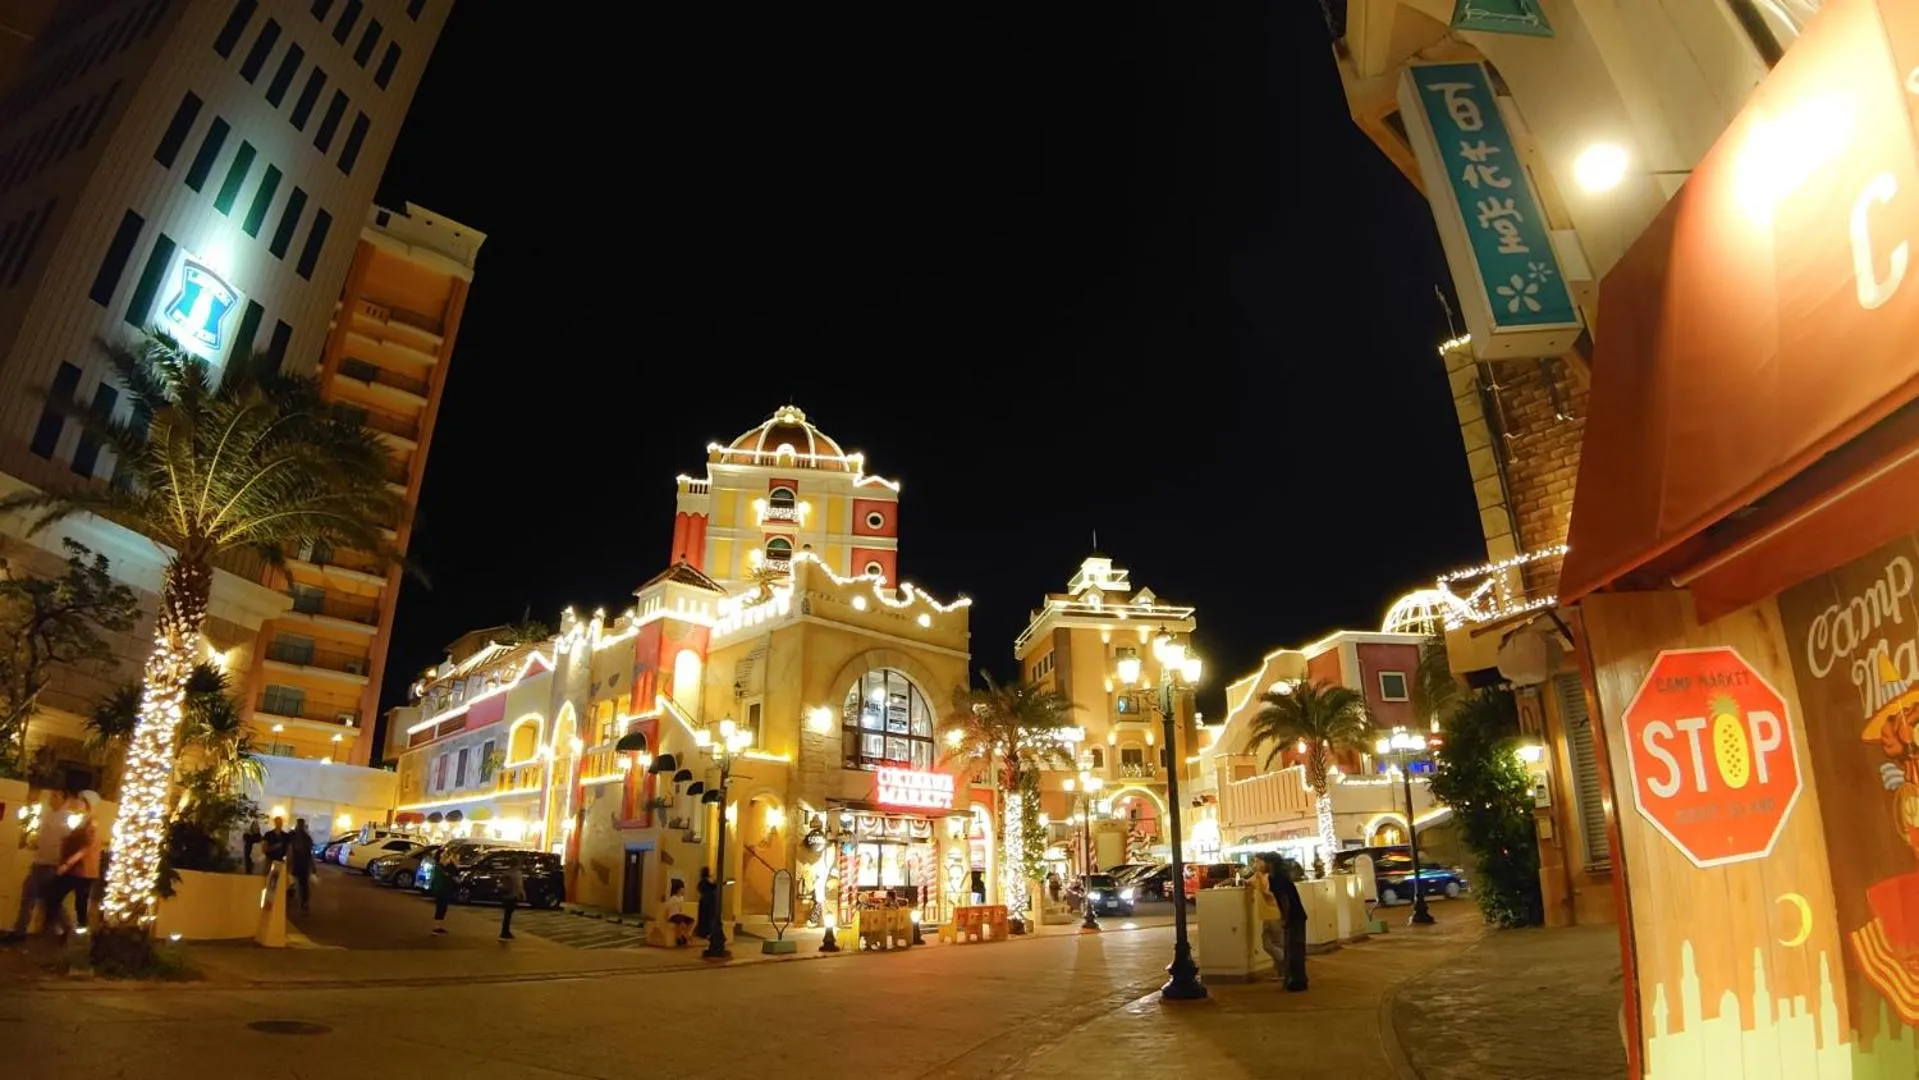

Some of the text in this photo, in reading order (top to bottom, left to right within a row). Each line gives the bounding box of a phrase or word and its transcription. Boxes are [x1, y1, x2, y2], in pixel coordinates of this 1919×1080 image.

[1426, 81, 1529, 254] 百花堂
[1807, 555, 1914, 679] Camp
[1699, 670, 1751, 689] MARKET
[1642, 710, 1782, 798] STOP
